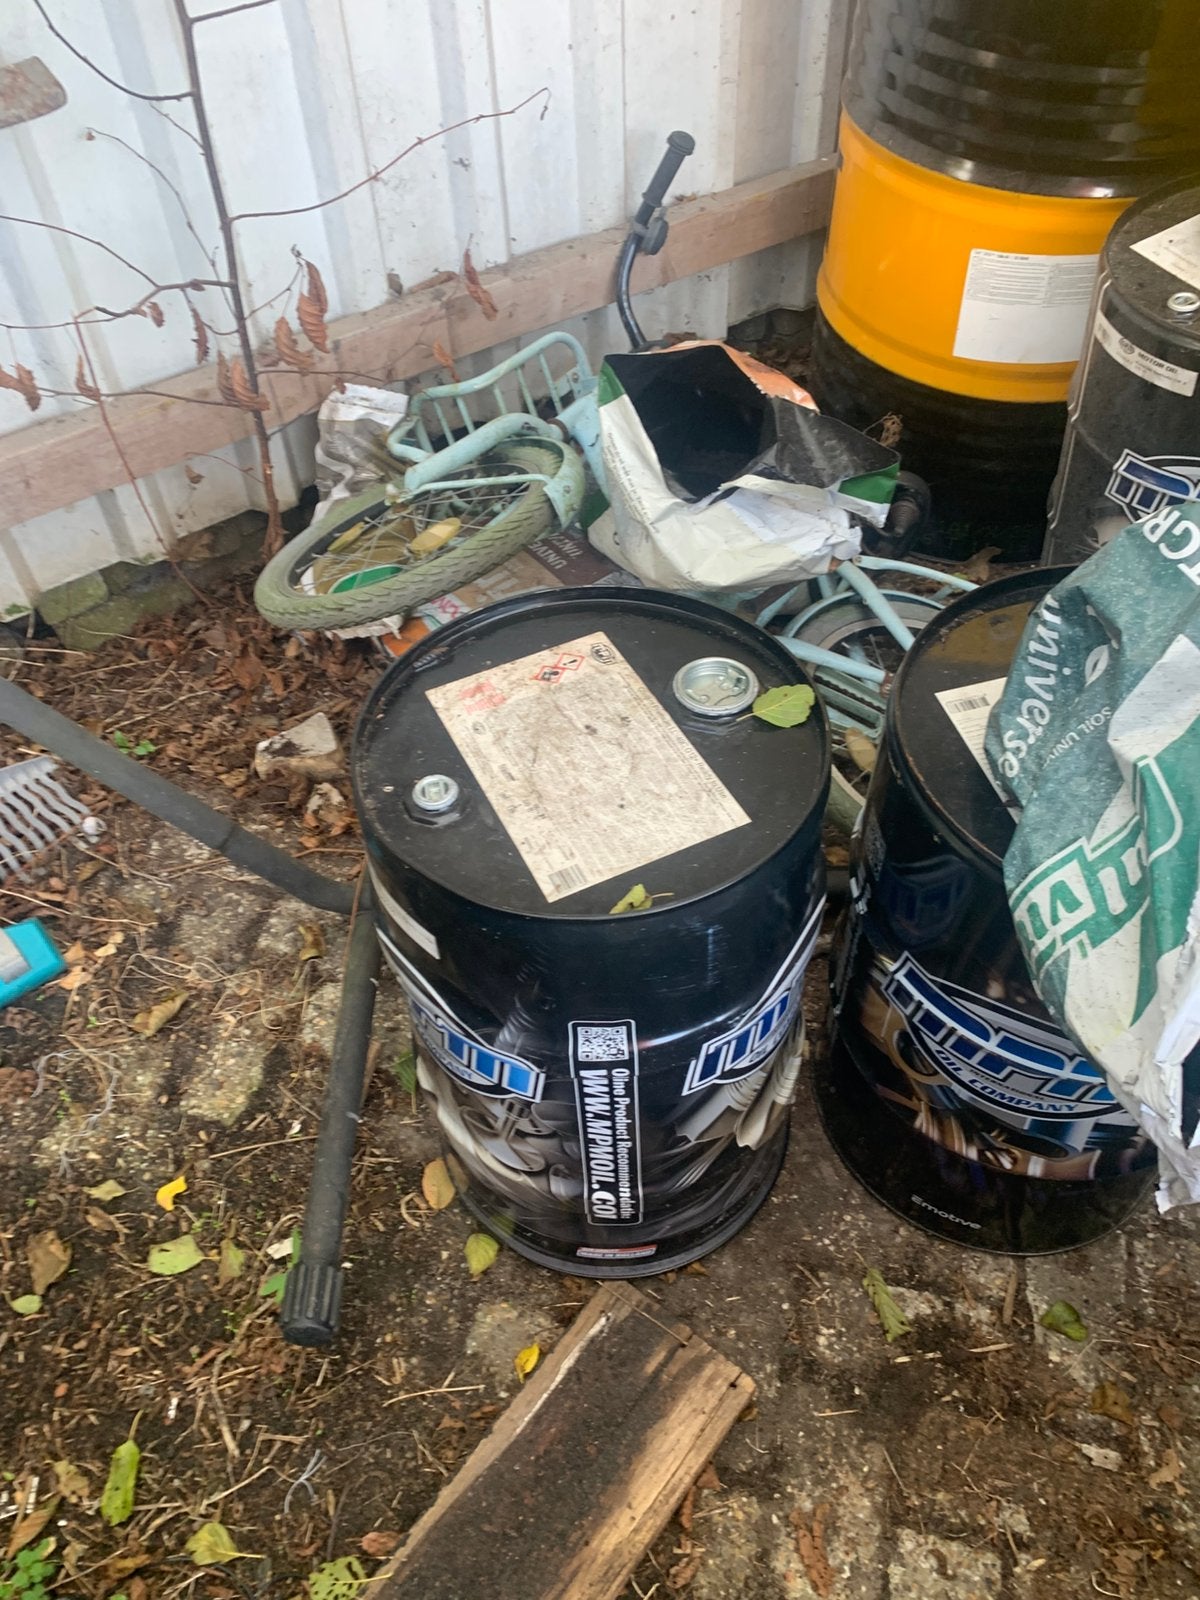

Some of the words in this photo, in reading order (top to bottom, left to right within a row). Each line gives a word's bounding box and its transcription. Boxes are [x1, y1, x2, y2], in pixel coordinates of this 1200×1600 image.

[1077, 706, 1113, 739] SOIL
[935, 1049, 964, 1076] OIL
[968, 1078, 1079, 1112] COMPANY
[613, 1101, 632, 1140] Product
